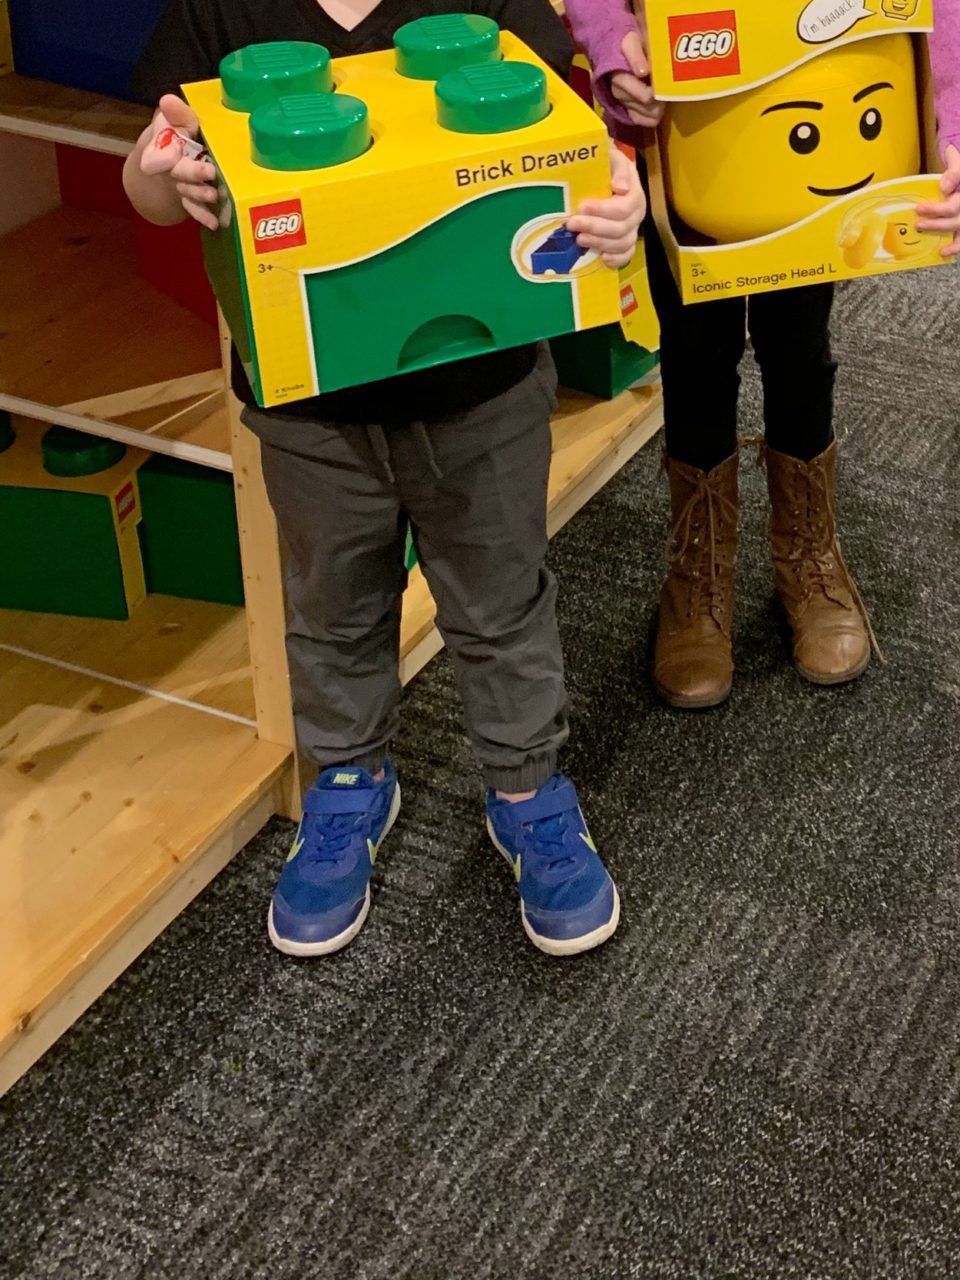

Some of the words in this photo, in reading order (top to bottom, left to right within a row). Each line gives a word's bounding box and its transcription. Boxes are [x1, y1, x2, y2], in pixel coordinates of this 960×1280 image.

[675, 29, 733, 61] LEGO
[456, 159, 514, 187] Brick
[521, 144, 599, 173] Drawer
[256, 213, 300, 238] LEGO
[257, 263, 273, 274] 3+
[691, 268, 707, 278] 3+
[692, 280, 733, 294] Iconic
[736, 272, 787, 288] Storage
[791, 264, 825, 279] Head
[828, 263, 836, 273] L
[332, 772, 359, 785] NIKE
